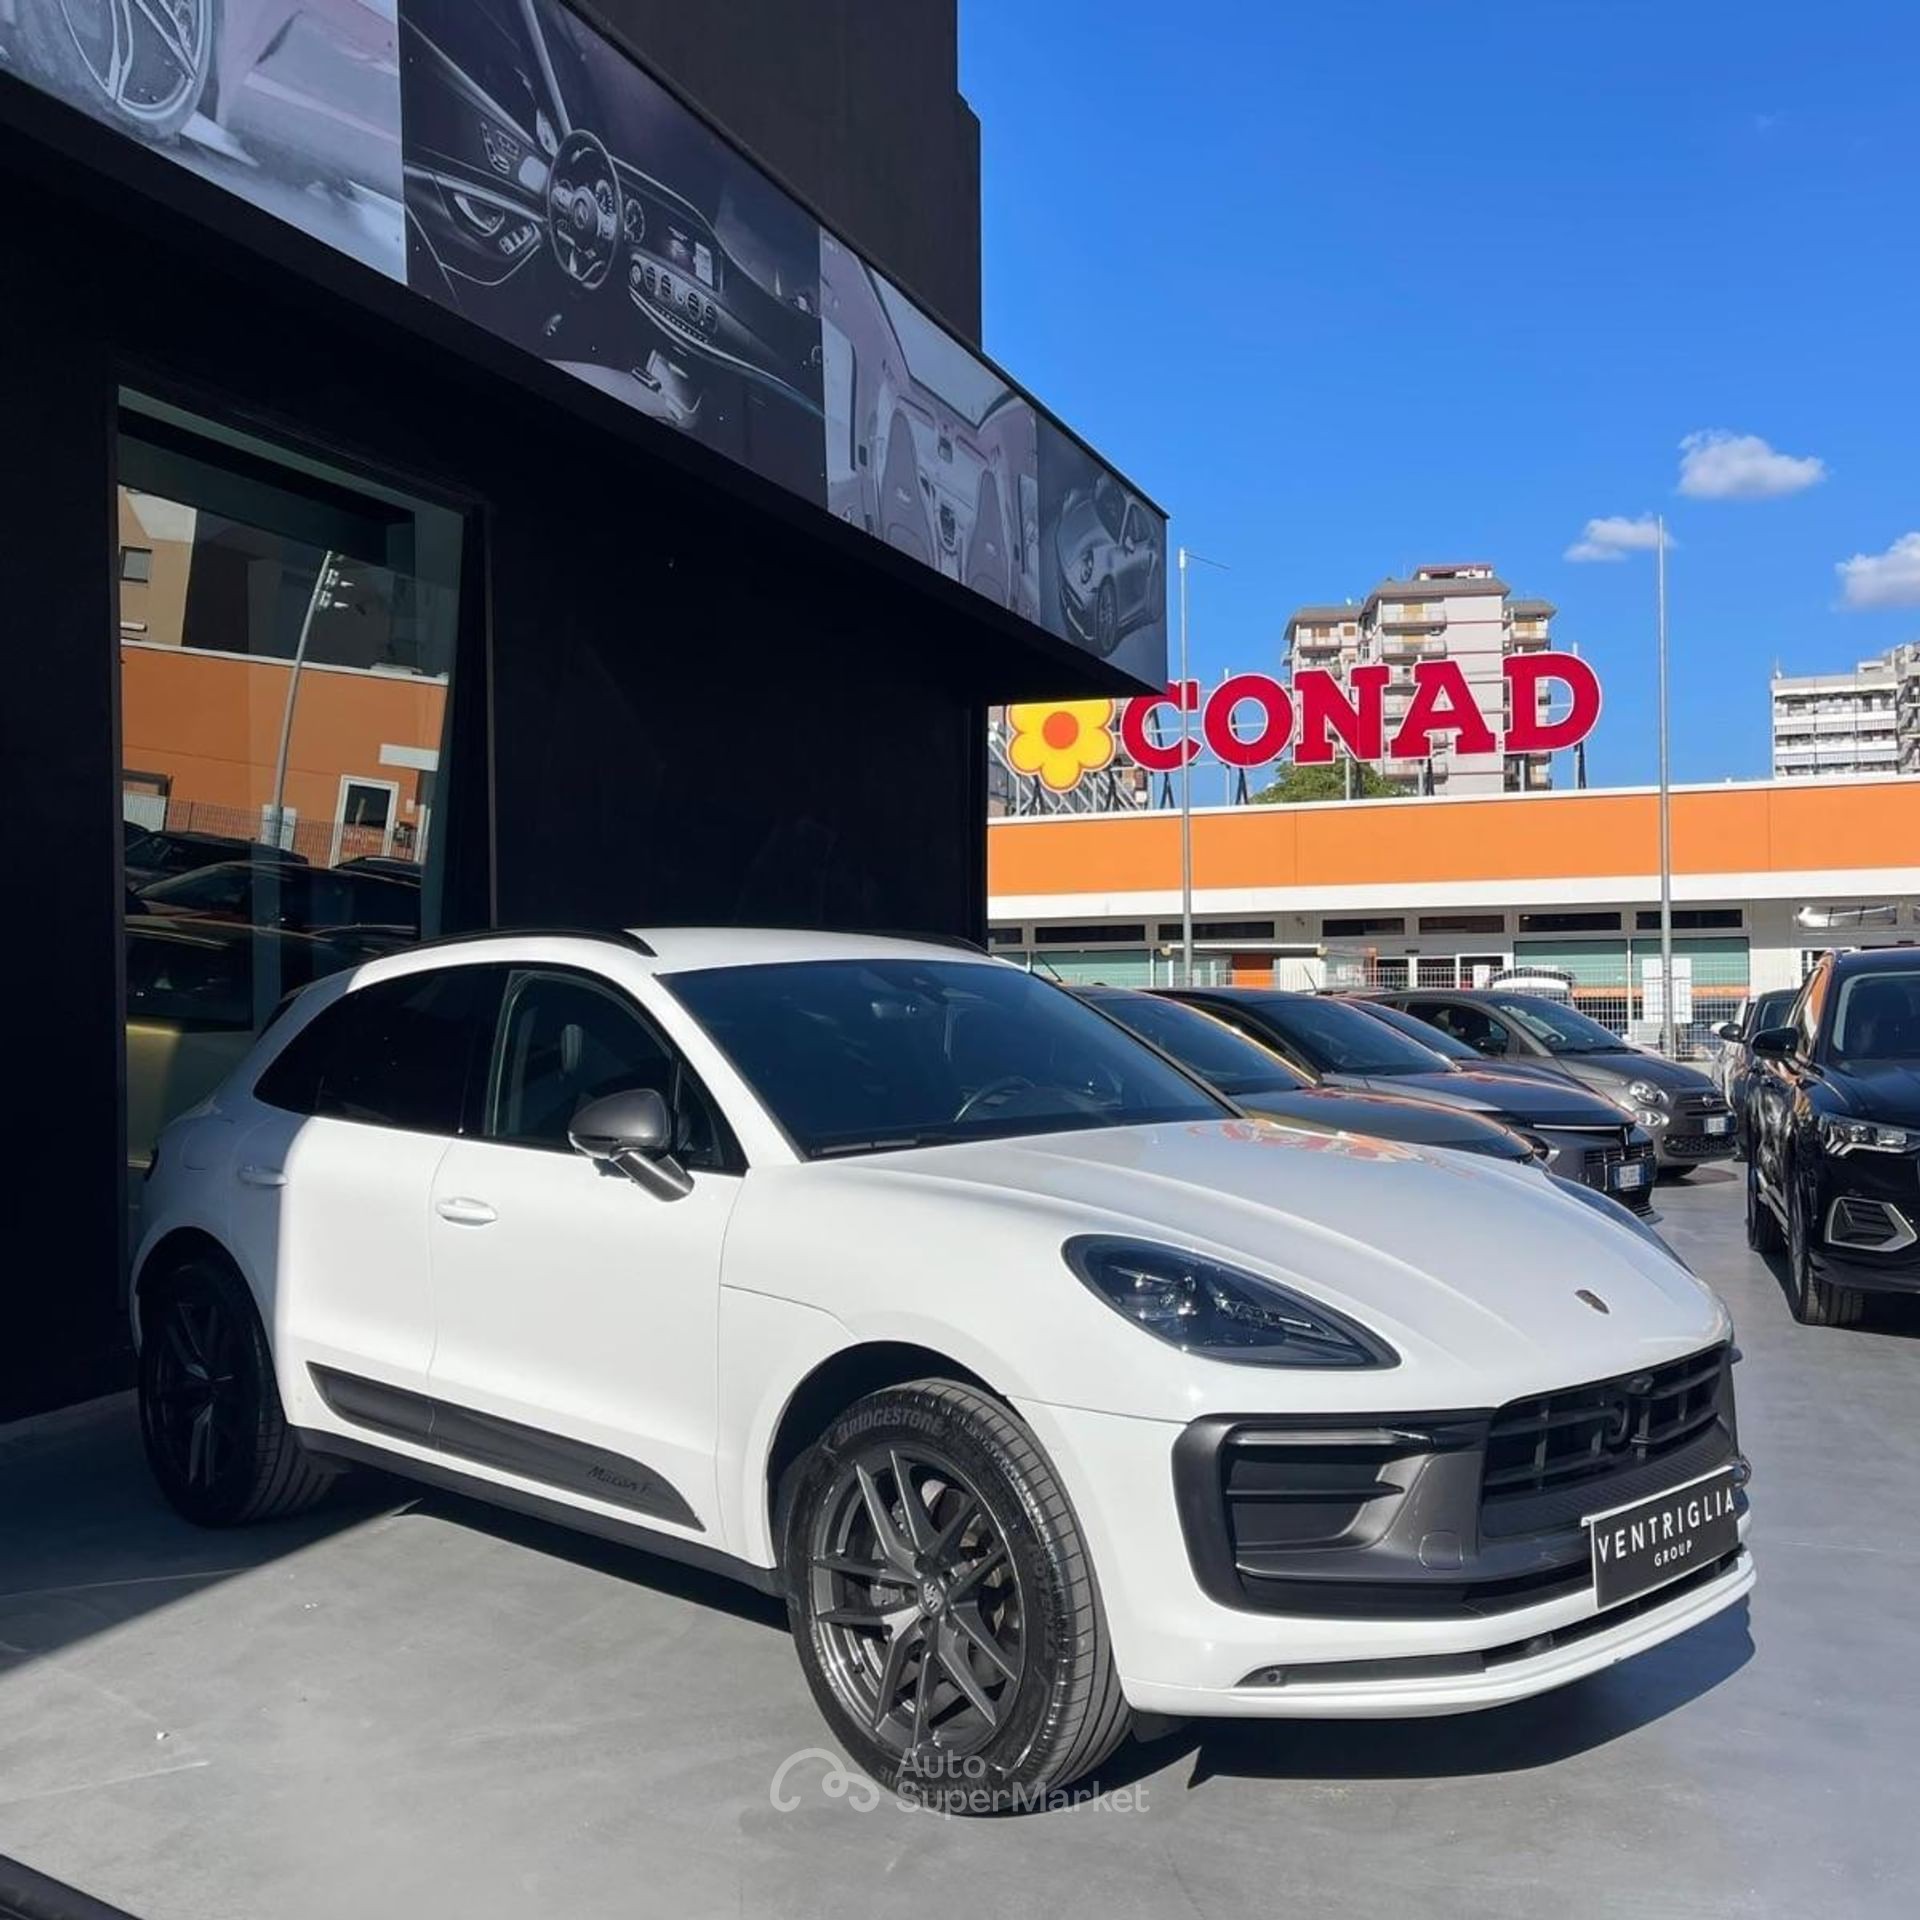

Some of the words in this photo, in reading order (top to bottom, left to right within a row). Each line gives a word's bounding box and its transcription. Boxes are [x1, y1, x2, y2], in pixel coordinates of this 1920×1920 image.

[1120, 651, 1602, 772] CONAD
[836, 1405, 946, 1446] BRIDGESTONE
[1597, 1487, 1735, 1563] VENTRIGLIA
[1654, 1540, 1693, 1567] GROUP
